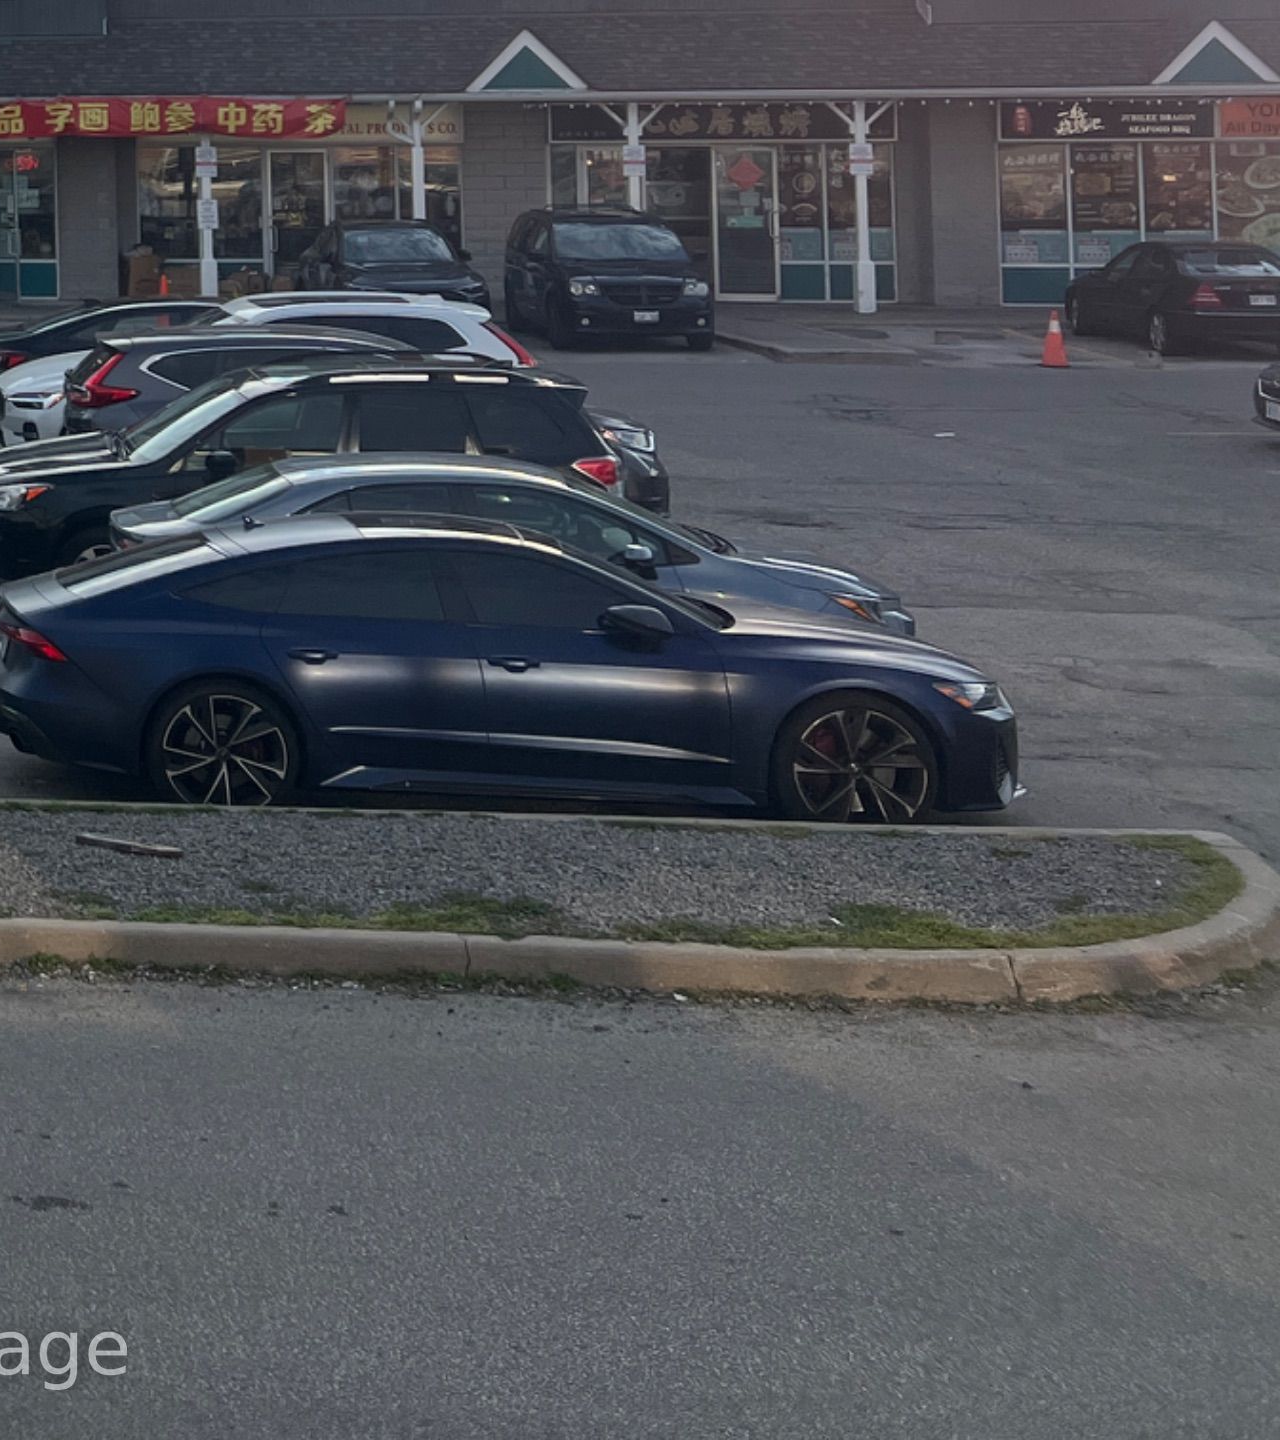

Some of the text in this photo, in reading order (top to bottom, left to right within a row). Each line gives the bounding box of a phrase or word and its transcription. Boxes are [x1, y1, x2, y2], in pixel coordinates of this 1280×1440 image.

[45, 102, 110, 133] 字画
[131, 102, 196, 133] 鲍参
[217, 103, 284, 134] 中药
[303, 102, 338, 135] 茶
